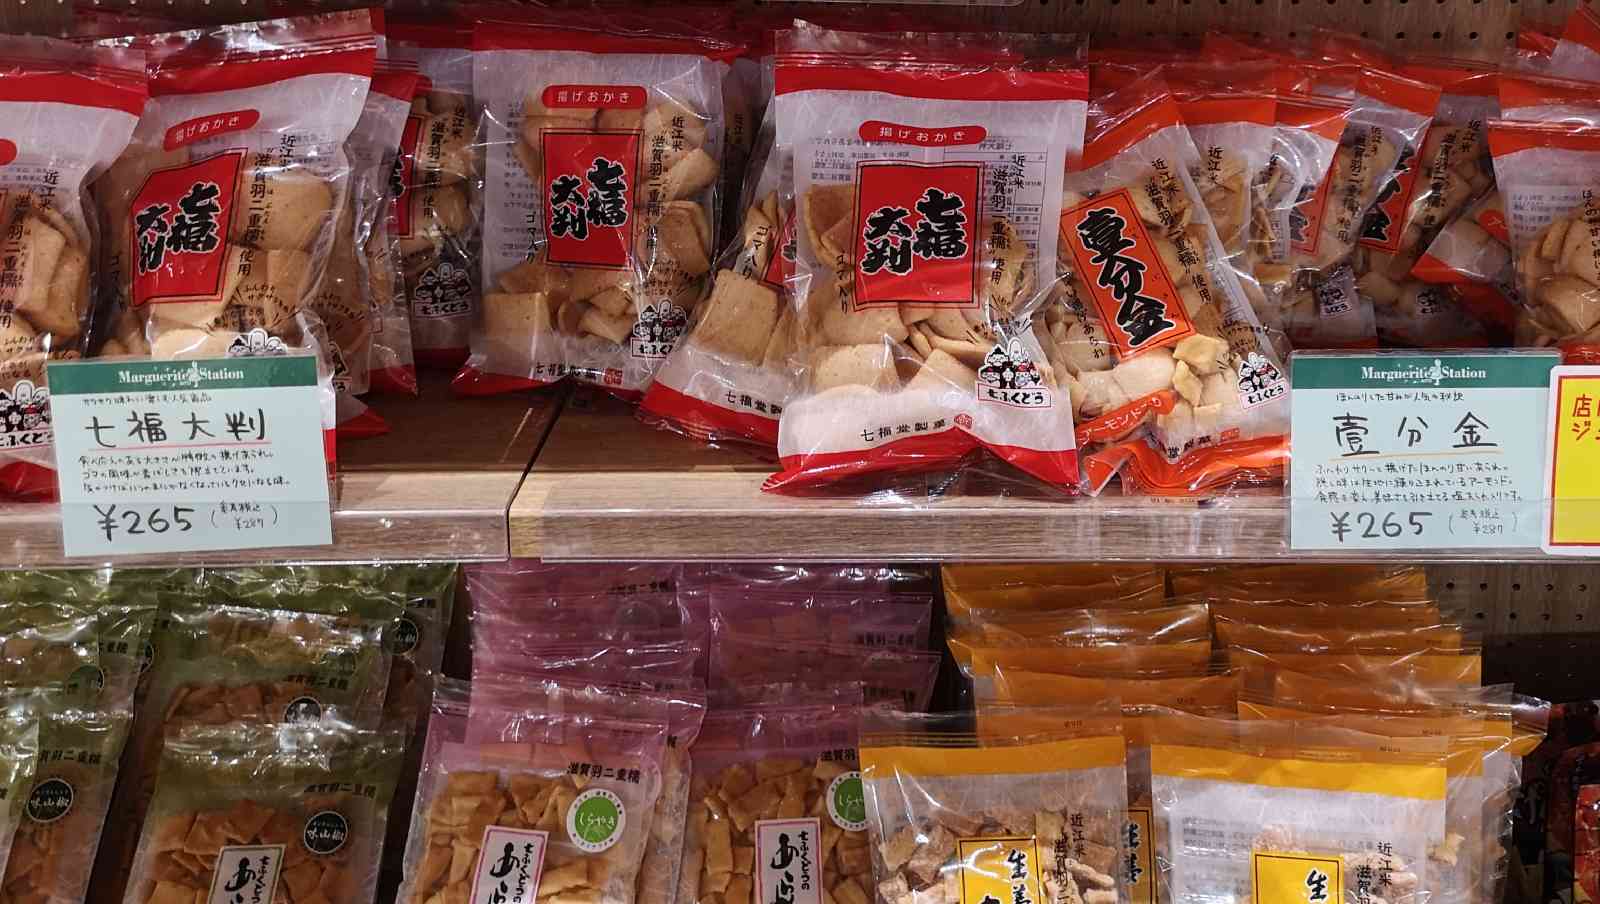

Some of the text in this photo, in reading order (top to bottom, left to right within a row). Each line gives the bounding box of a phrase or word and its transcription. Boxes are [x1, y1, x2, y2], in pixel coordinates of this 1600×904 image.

[558, 91, 630, 103] 揚げおかき
[175, 116, 240, 143] 揚げおかき
[671, 116, 685, 152] 近江米
[880, 126, 967, 142] 揚げおかき
[1012, 154, 1025, 189] 近江米
[1151, 158, 1179, 196] 近江米
[118, 367, 244, 385] Marguerite Station
[1361, 365, 1486, 381] Marguerite Station
[1572, 394, 1600, 417] 店
[85, 408, 266, 448] 七福大判
[861, 419, 945, 442] 七福堂製菓
[1572, 420, 1600, 441] ジ
[93, 504, 194, 542] ¥265
[1330, 511, 1432, 542] ¥265
[1377, 841, 1393, 887] 近江米
[1306, 869, 1328, 901] 生
